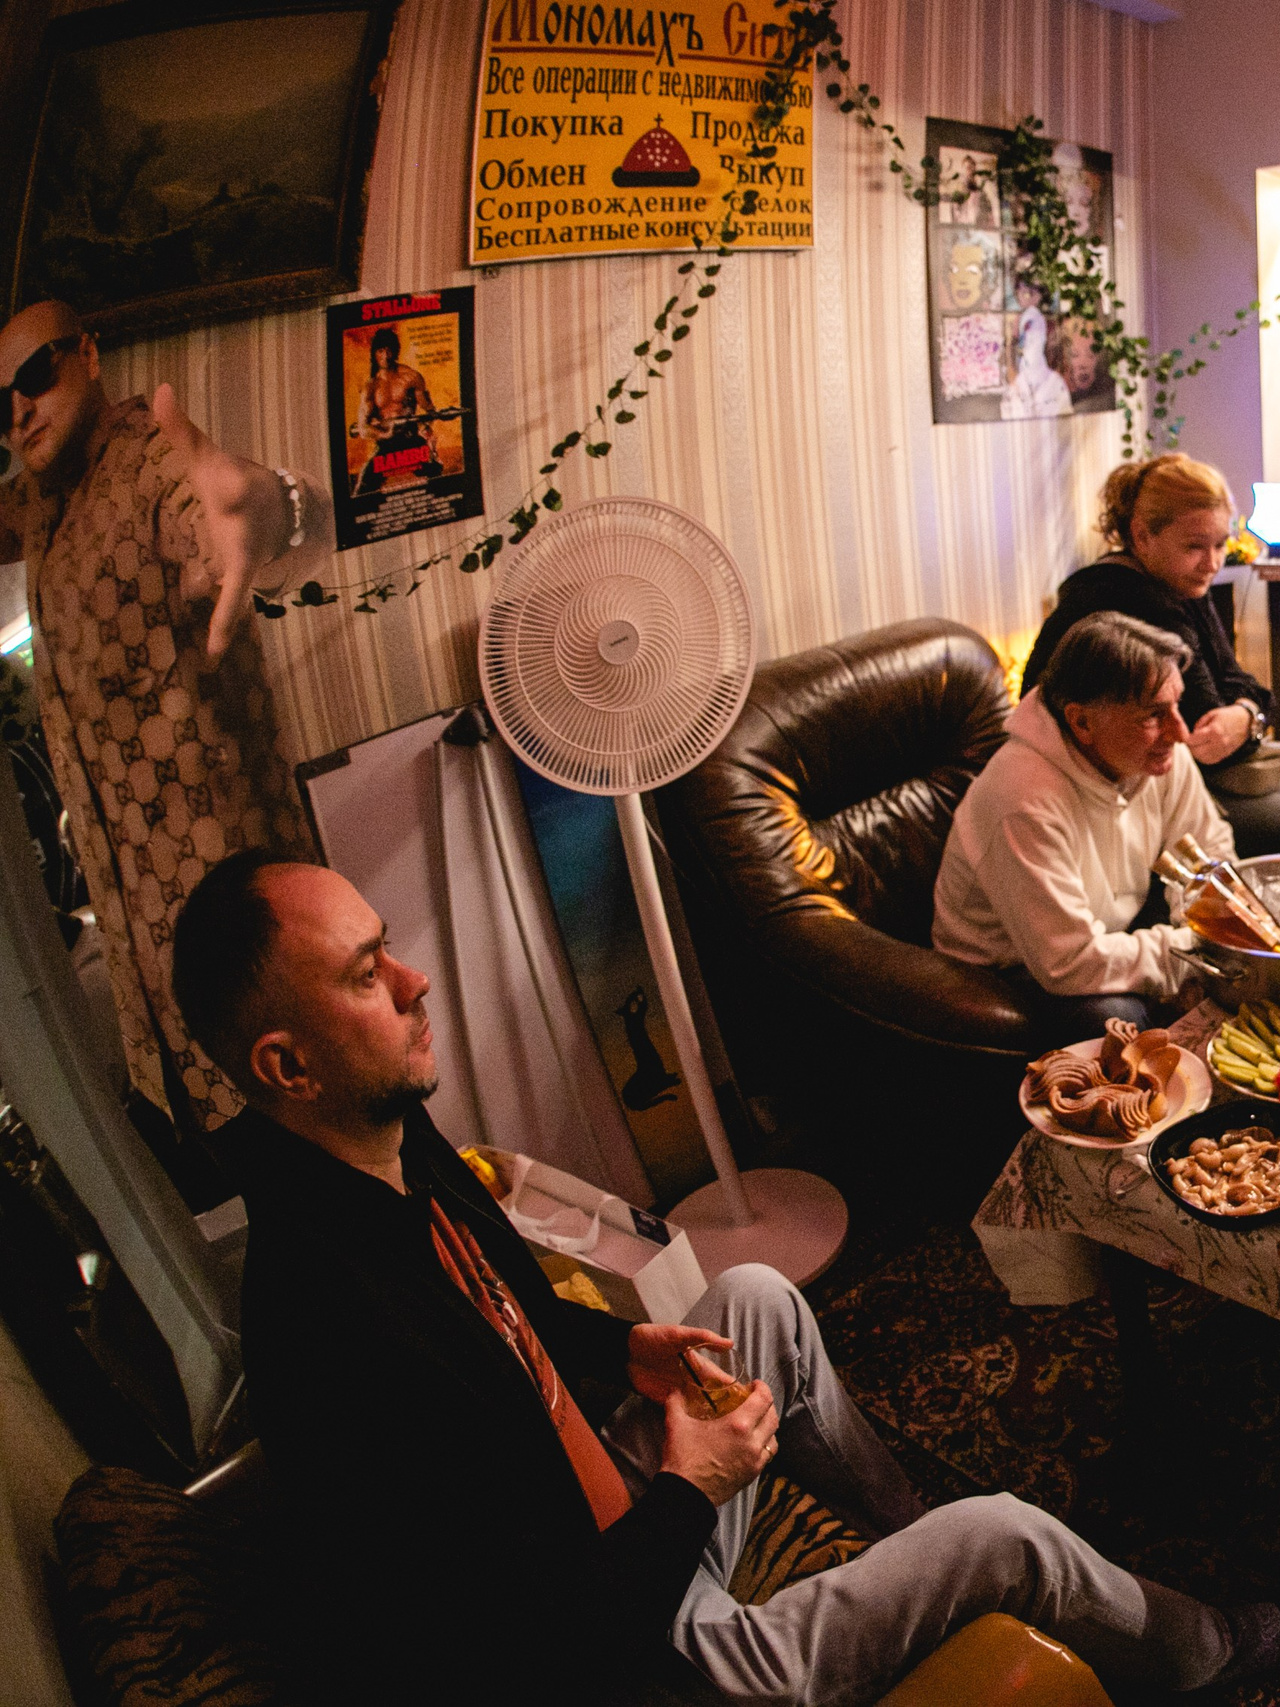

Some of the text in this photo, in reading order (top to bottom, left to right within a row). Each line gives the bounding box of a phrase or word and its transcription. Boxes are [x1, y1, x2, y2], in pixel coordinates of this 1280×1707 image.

[485, 57, 525, 95] Все
[533, 65, 638, 104] операции
[642, 69, 654, 96] с
[483, 108, 624, 145] Покупка
[690, 111, 805, 148] Продажа
[479, 158, 587, 191] Обмен
[476, 196, 812, 223] Сопровождение селок
[475, 219, 812, 250] Бесплатные консуьтации
[361, 292, 442, 321] STALLONE
[373, 445, 430, 473] RAMBO
